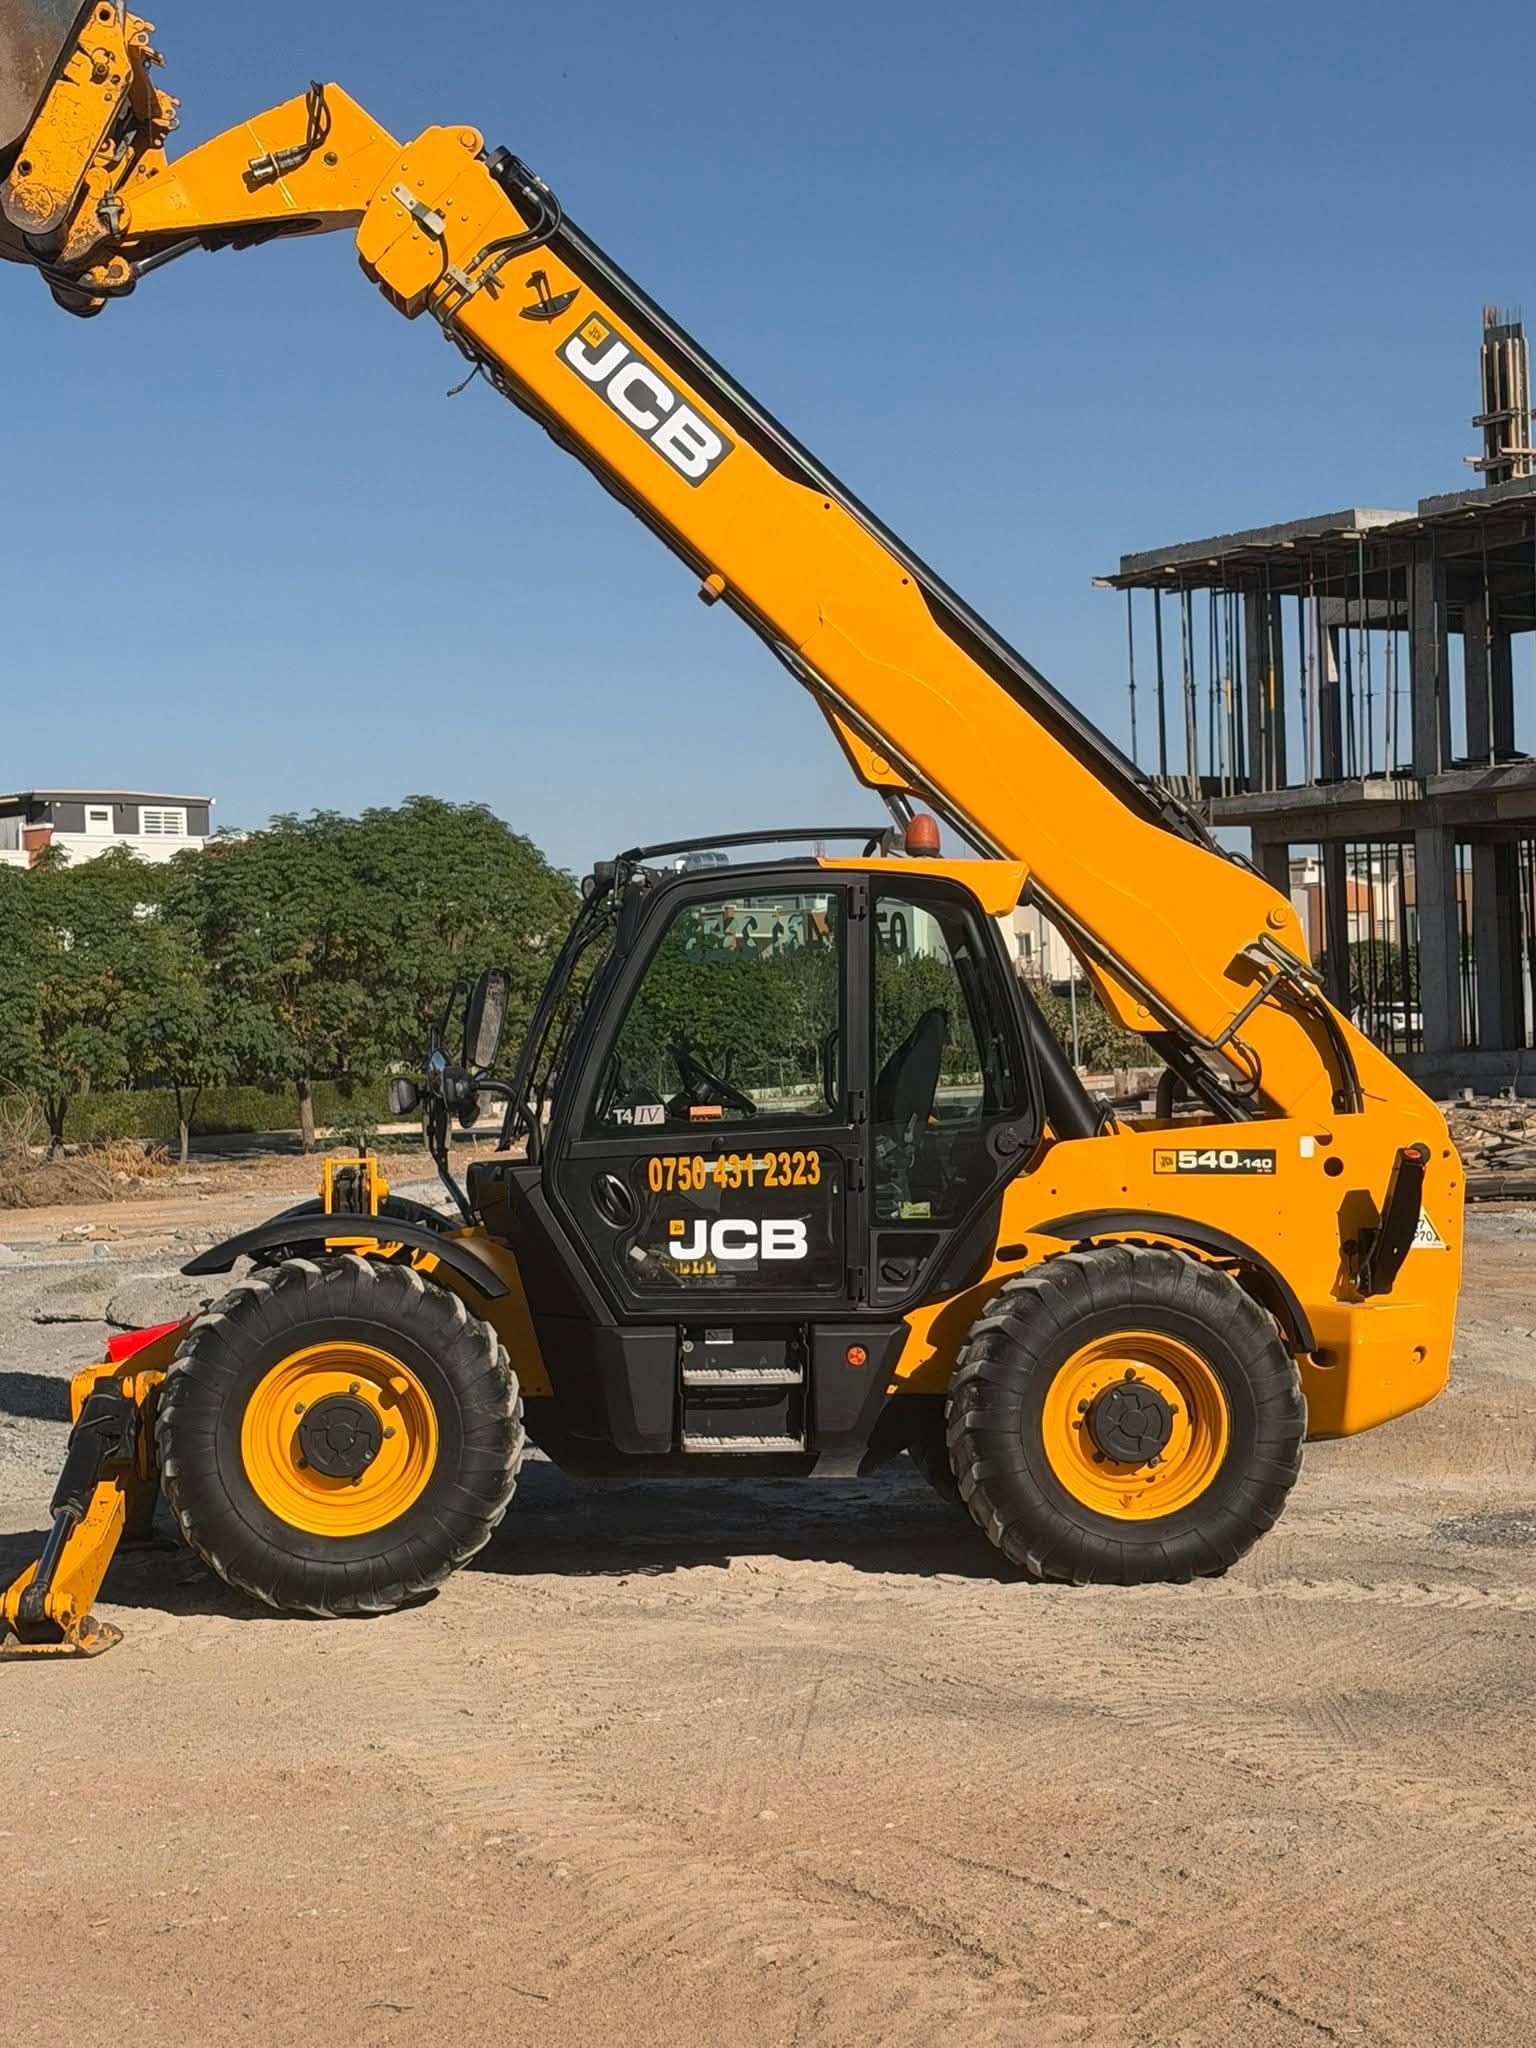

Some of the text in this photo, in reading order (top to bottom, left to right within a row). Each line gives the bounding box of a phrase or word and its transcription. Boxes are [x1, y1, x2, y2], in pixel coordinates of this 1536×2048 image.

[565, 337, 722, 478] JCB
[612, 1106, 661, 1125] T4 IV
[649, 1150, 821, 1192] 0750 431 2323
[669, 1219, 808, 1260] JCB
